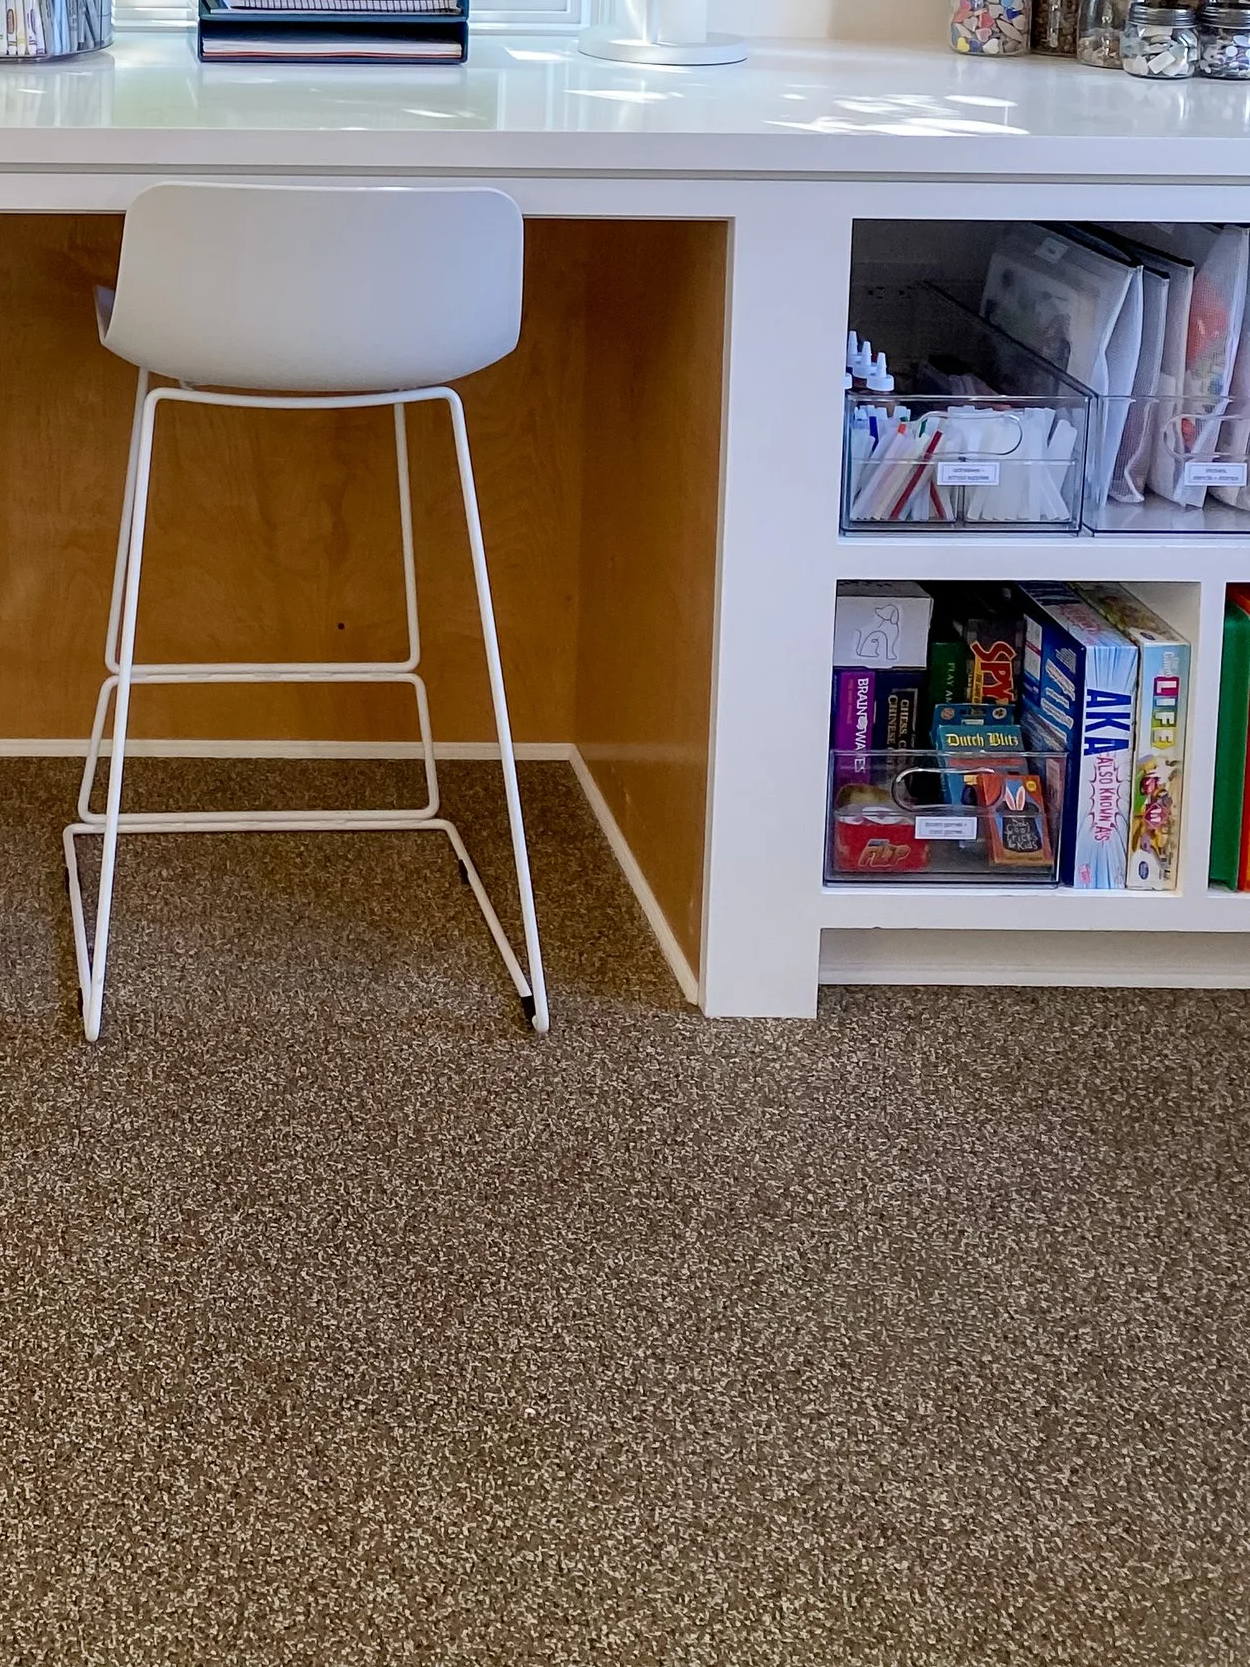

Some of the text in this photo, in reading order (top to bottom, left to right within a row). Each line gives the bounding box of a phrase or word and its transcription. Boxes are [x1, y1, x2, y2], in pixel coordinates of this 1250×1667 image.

[969, 640, 1017, 702] SPY
[945, 732, 1019, 747] Dutch Blitz
[1084, 688, 1132, 756] AKA
[1152, 678, 1178, 745] LIFE
[1096, 757, 1115, 783] ALSO
